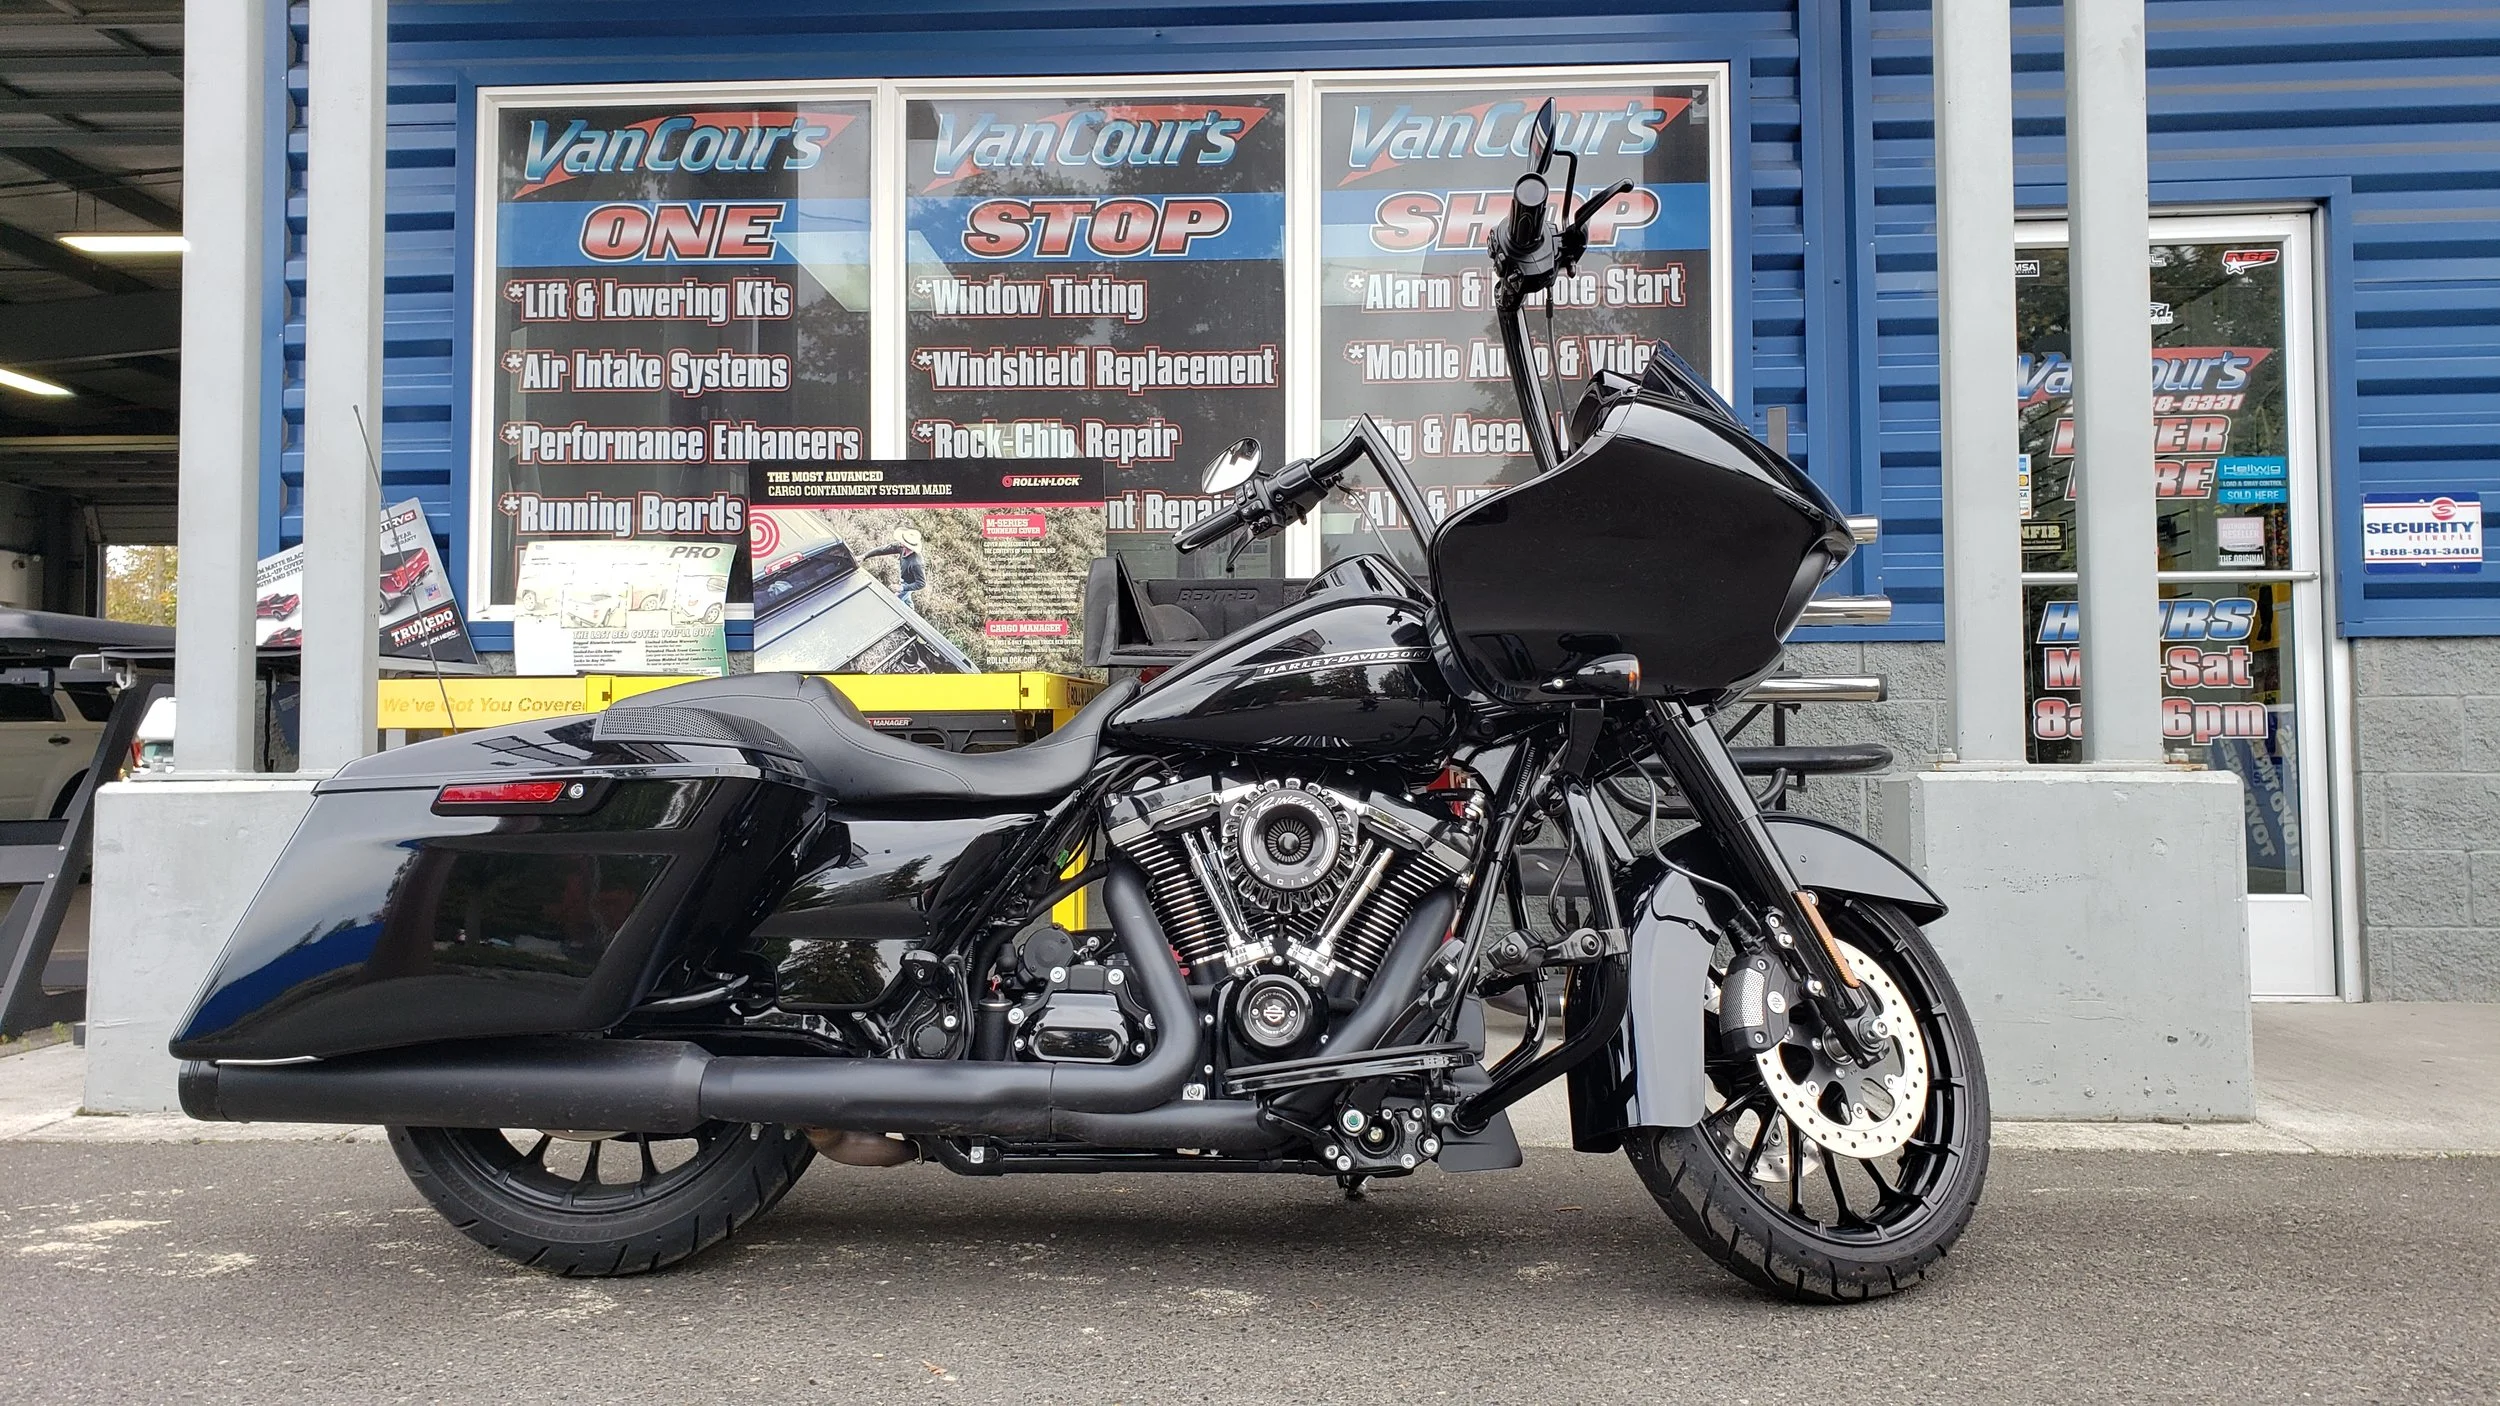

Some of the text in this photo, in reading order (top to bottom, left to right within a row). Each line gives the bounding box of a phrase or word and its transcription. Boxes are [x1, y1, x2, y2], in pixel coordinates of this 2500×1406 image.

[523, 116, 828, 182] VanCour's
[932, 110, 1245, 176] VanCour's
[578, 201, 788, 263] ONE
[962, 197, 1232, 259] STOP
[1369, 187, 1661, 253] SHP
[574, 281, 597, 319] &
[604, 280, 728, 325] Lowering
[736, 280, 790, 318] Kits
[1049, 278, 1145, 321] Tinting
[1461, 272, 1482, 308] &
[1491, 270, 1597, 307] ote
[1606, 266, 1682, 305] Start
[575, 351, 662, 389] Intake
[669, 351, 789, 395] Systems
[1095, 347, 1276, 393] Replacement
[1469, 341, 1549, 379] Auo
[1559, 340, 1580, 376] &
[2017, 350, 2250, 400] Vaour's
[2153, 393, 2245, 411] 8-6331
[712, 422, 860, 461] Enhancers
[1085, 422, 1180, 466] Repair
[1423, 418, 1443, 454] &
[1452, 417, 1533, 454] Acce
[767, 471, 884, 483] THE MOST ADVANCED
[2223, 464, 2281, 475] Hellwig
[768, 484, 952, 497] CARGO CONTAINMENT SYSTEM MADE
[2227, 490, 2279, 500] SOLD HERE
[641, 495, 743, 533] Boards
[986, 518, 1029, 527] M-SERIES
[1105, 493, 1236, 534] nt Repai
[2366, 521, 2475, 534] SECURITY
[286, 551, 304, 564] BLAC
[669, 545, 721, 559] PRO
[2220, 554, 2264, 562] THE ORIGINAL
[2367, 547, 2480, 556] 1-888-941-3400
[573, 627, 715, 639] THE LAST BED COVER YOU'LL BUY!
[989, 623, 1062, 633] CARGO MANAGER
[2037, 599, 2257, 643] HRS
[1262, 648, 1430, 676] HARLEY-DAVIDSON
[2045, 646, 2253, 689] M-Sat
[382, 696, 587, 713] We've Got You Covere
[873, 718, 909, 726] MANAGER
[1251, 794, 1330, 826] RINEHART
[1252, 863, 1321, 886] RACING
